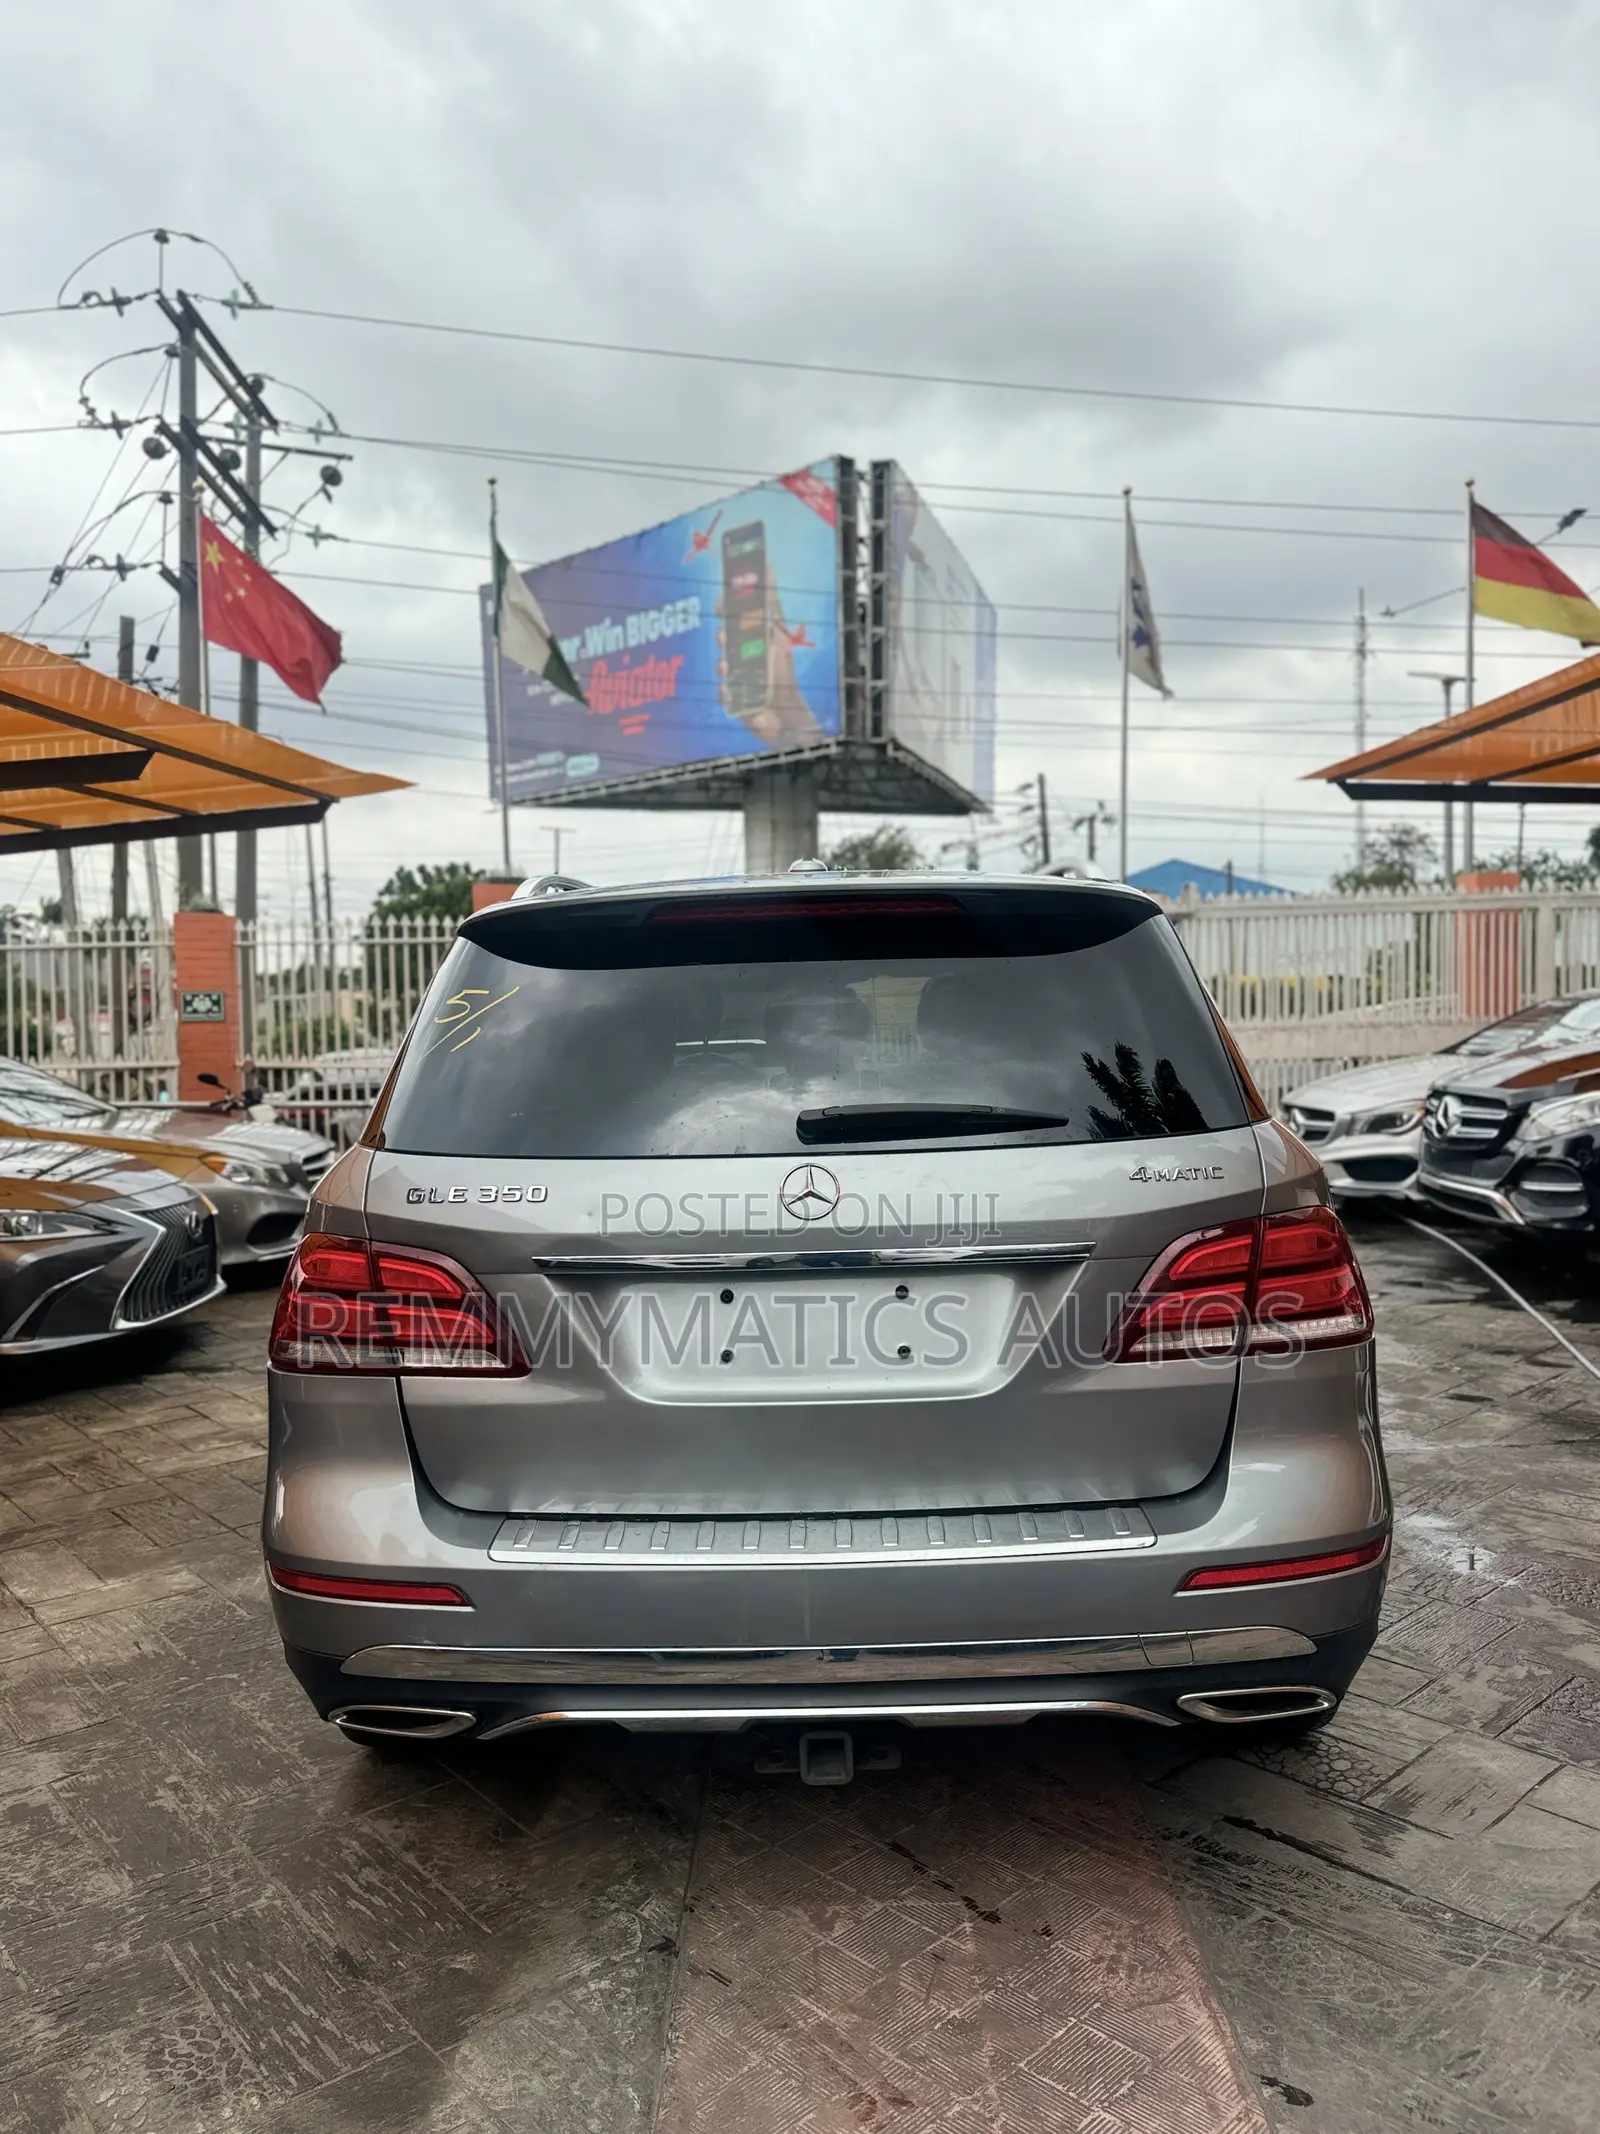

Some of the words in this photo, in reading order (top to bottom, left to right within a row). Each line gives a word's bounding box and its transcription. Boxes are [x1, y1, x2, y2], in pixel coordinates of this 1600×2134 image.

[584, 616, 625, 658] Win
[625, 596, 701, 648] BIGGER
[1129, 1166, 1225, 1182] 4MATIC
[406, 1186, 469, 1204] GLE
[478, 1185, 548, 1203] 350
